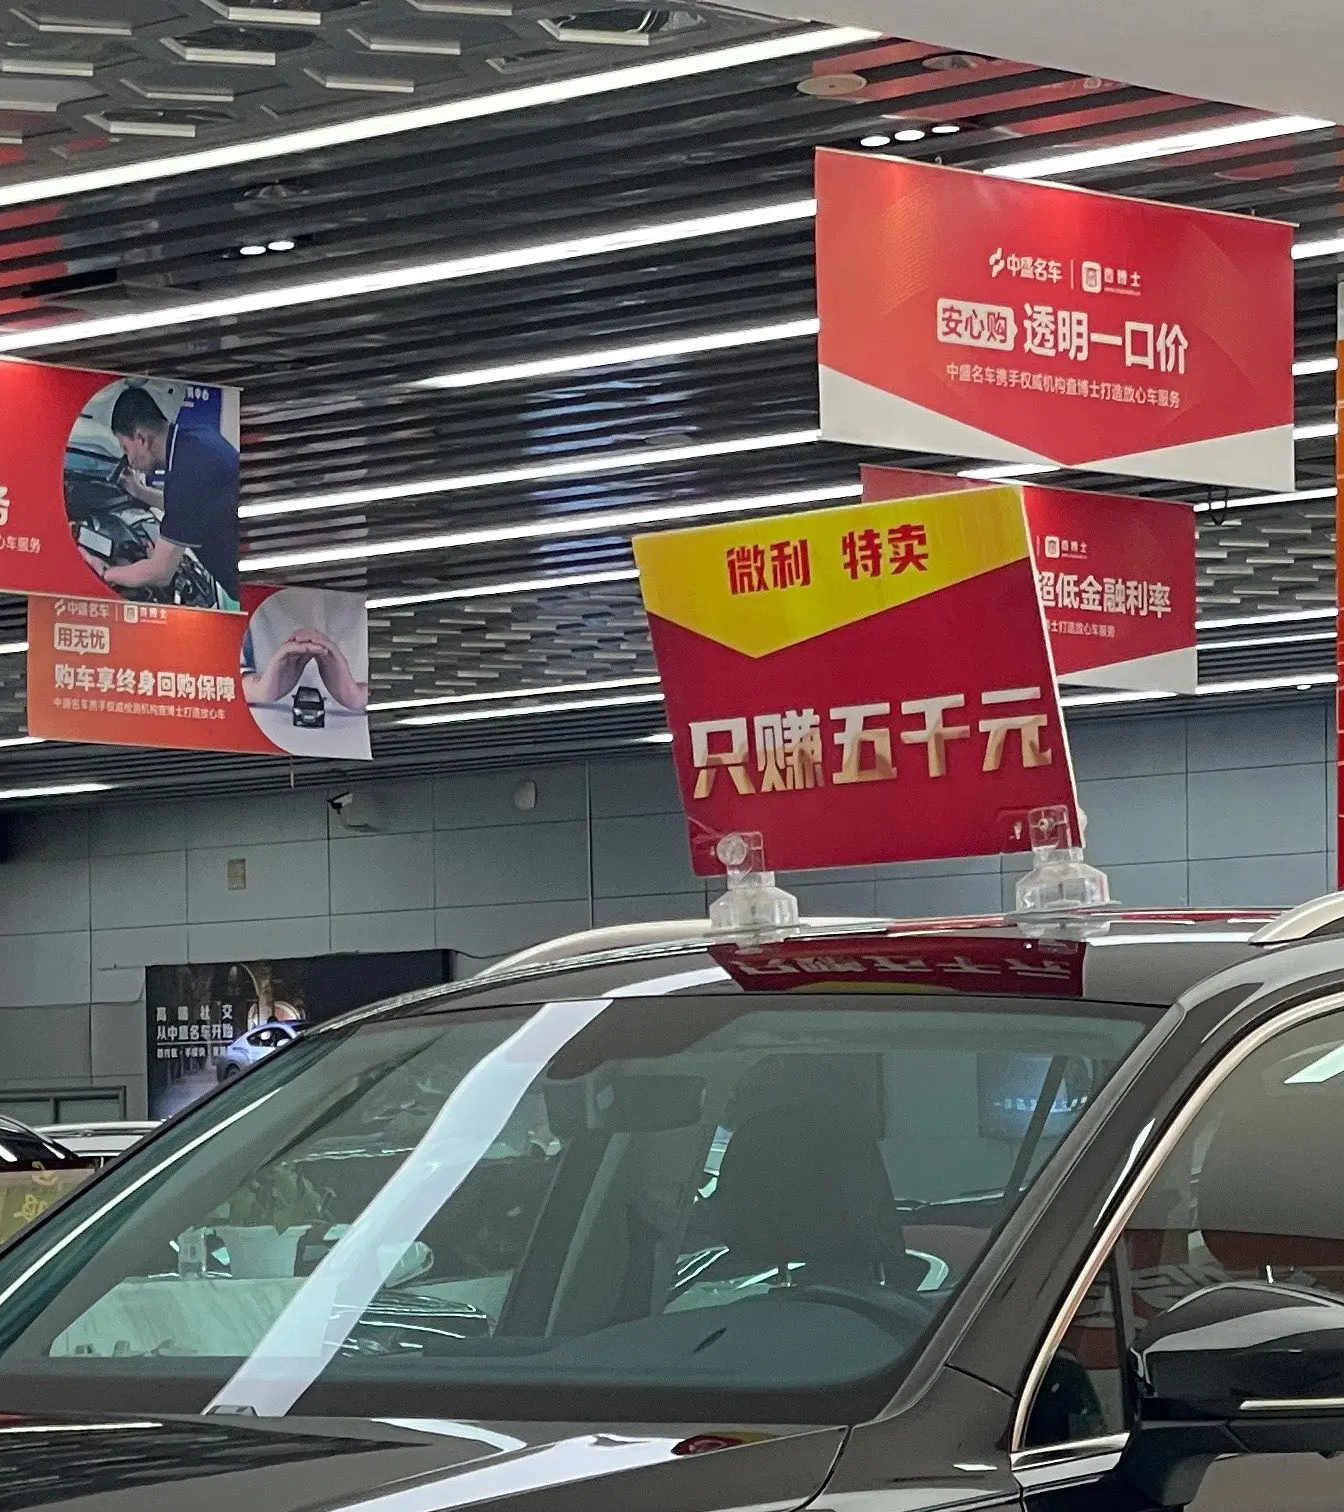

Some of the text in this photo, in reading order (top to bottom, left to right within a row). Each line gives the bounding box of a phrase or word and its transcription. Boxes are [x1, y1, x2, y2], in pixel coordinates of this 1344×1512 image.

[1006, 253, 1062, 284] 中盛名车
[941, 302, 1190, 375] 安心购 透明一口价
[727, 524, 930, 596] 微利 特卖
[67, 599, 110, 619] 中盛名车
[58, 627, 106, 651] 用无忧
[1047, 620, 1116, 638] 士打造放心车服务
[54, 664, 236, 704] 购车享终身回购保障
[688, 686, 1051, 799] 只赚五千元
